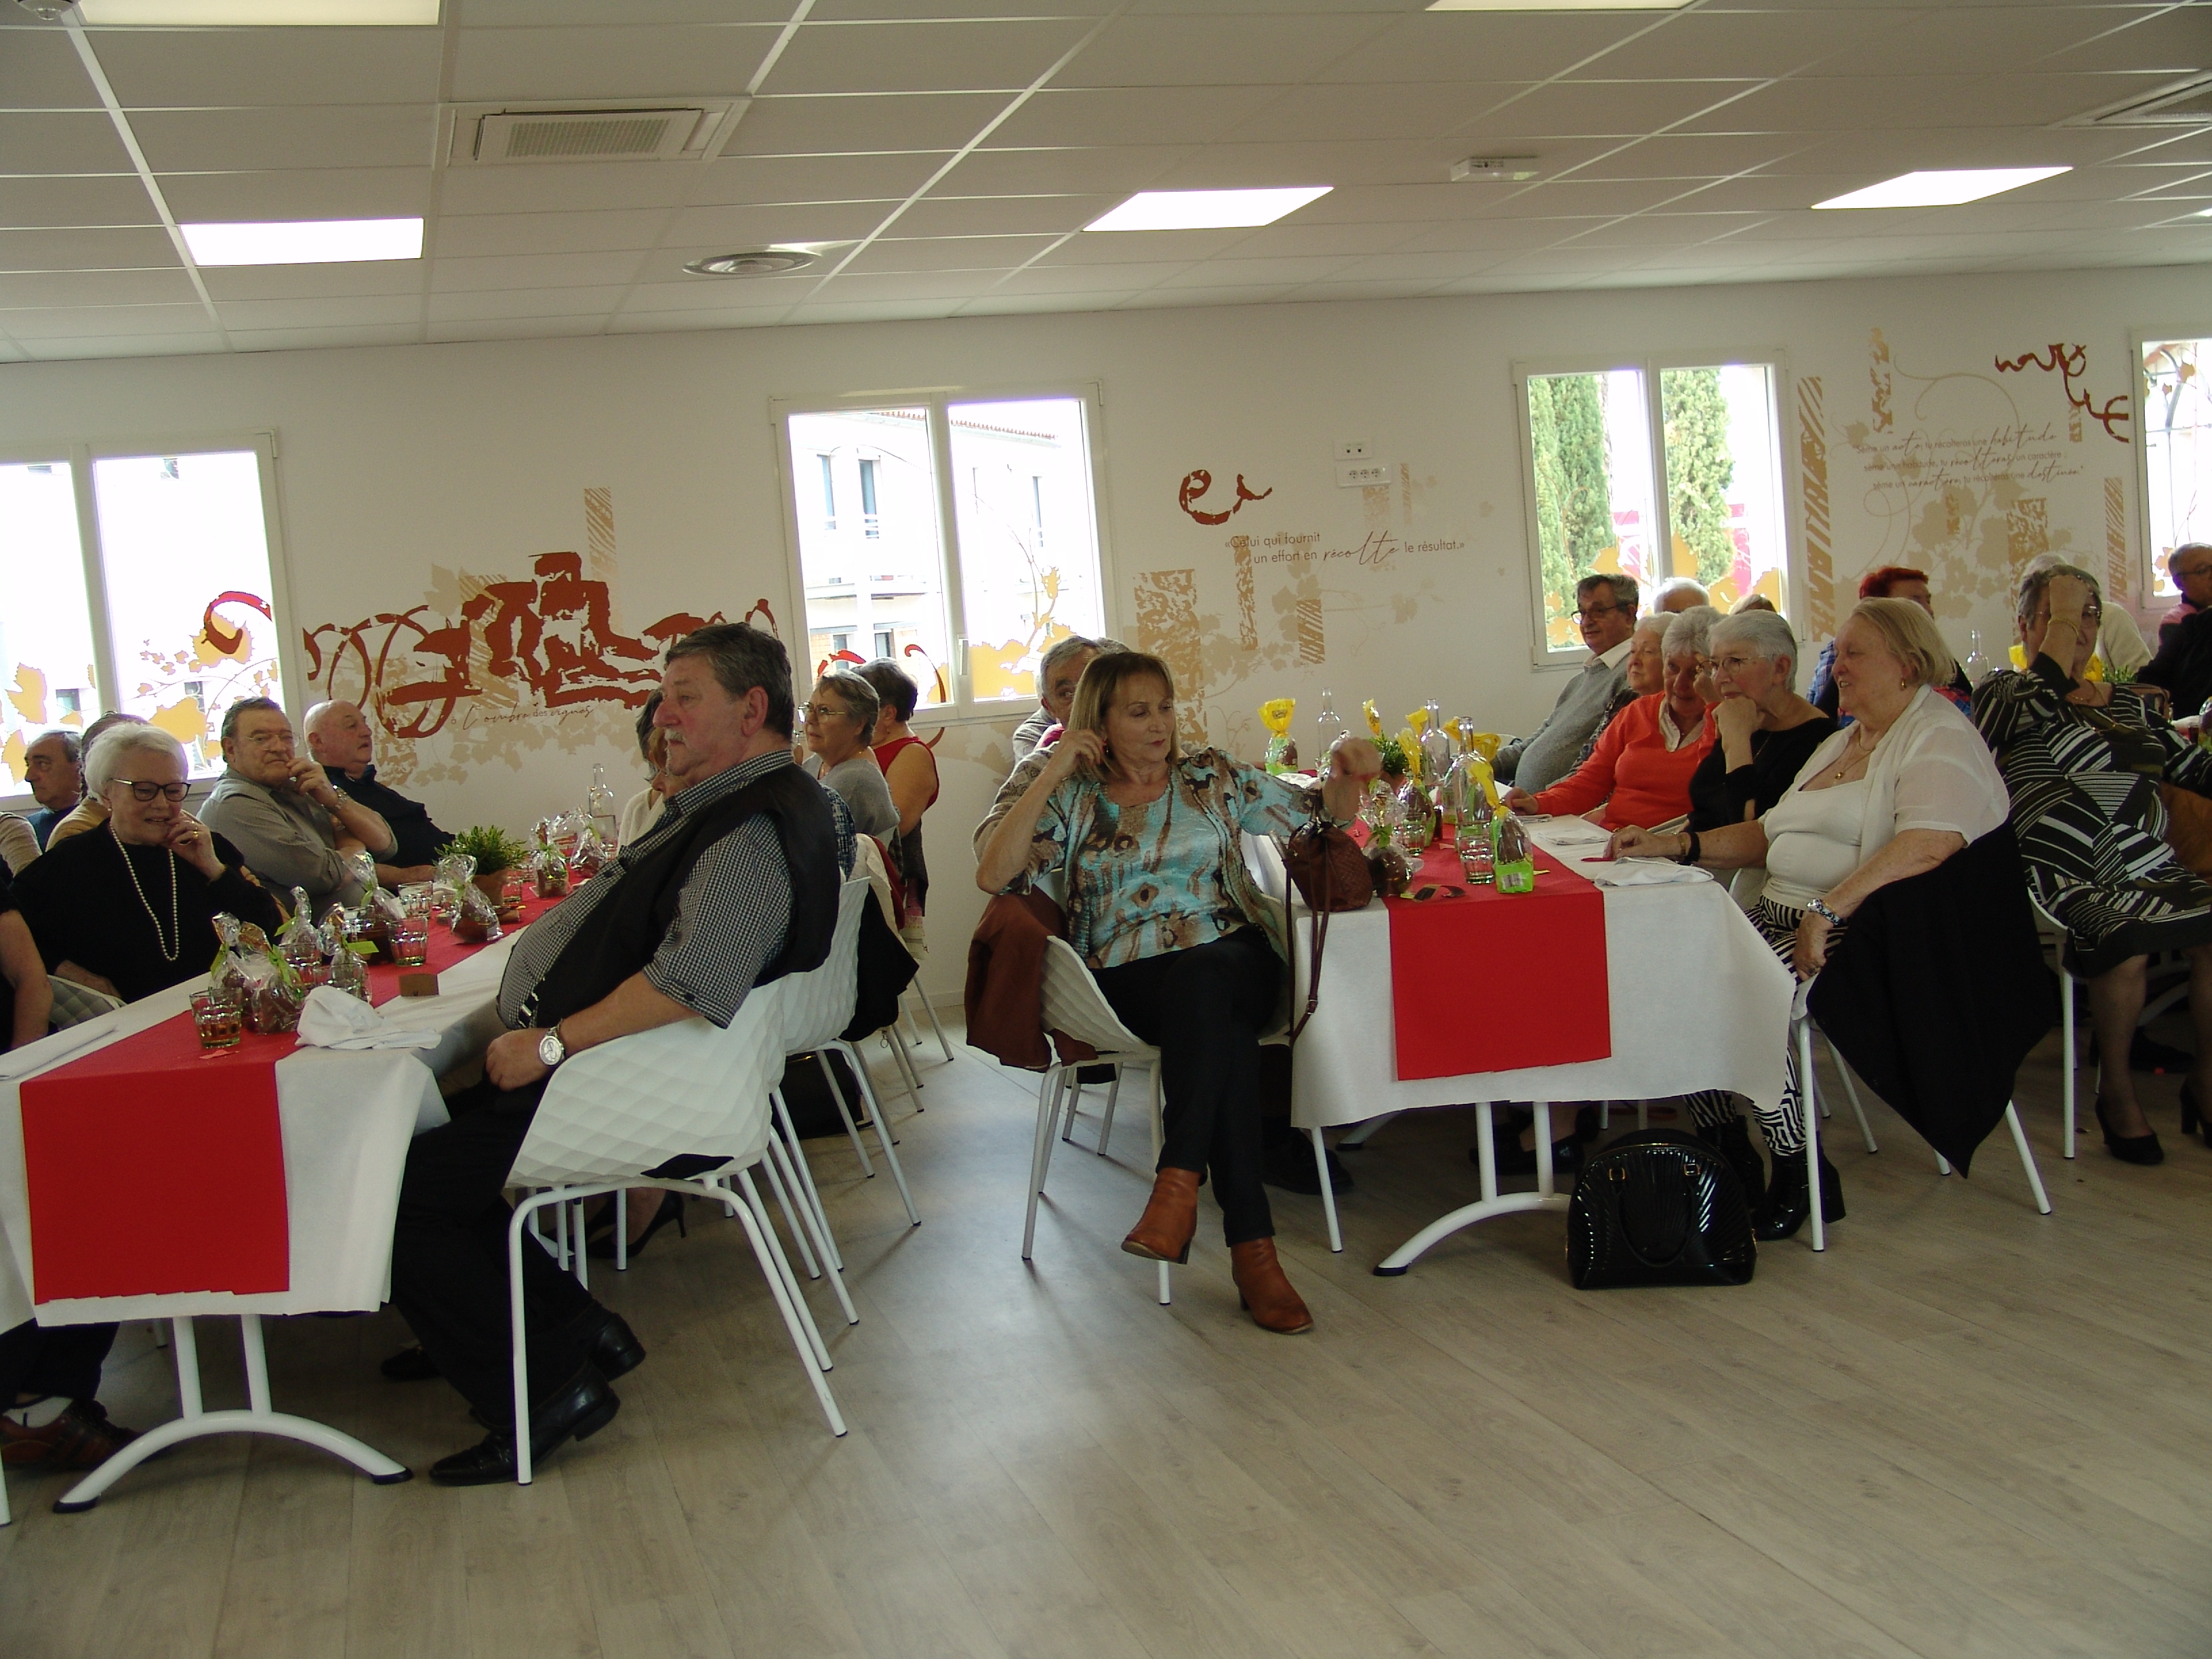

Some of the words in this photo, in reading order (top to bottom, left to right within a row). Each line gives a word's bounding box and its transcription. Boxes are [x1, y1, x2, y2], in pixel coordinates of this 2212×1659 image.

[1254, 555, 1268, 564] un
[1271, 550, 1300, 563] effort
[1304, 552, 1317, 560] en
[1322, 530, 1399, 565] récolte
[1404, 541, 1414, 553] le
[1263, 534, 1282, 548] qui
[1285, 531, 1320, 545] fournit
[533, 708, 548, 717] des
